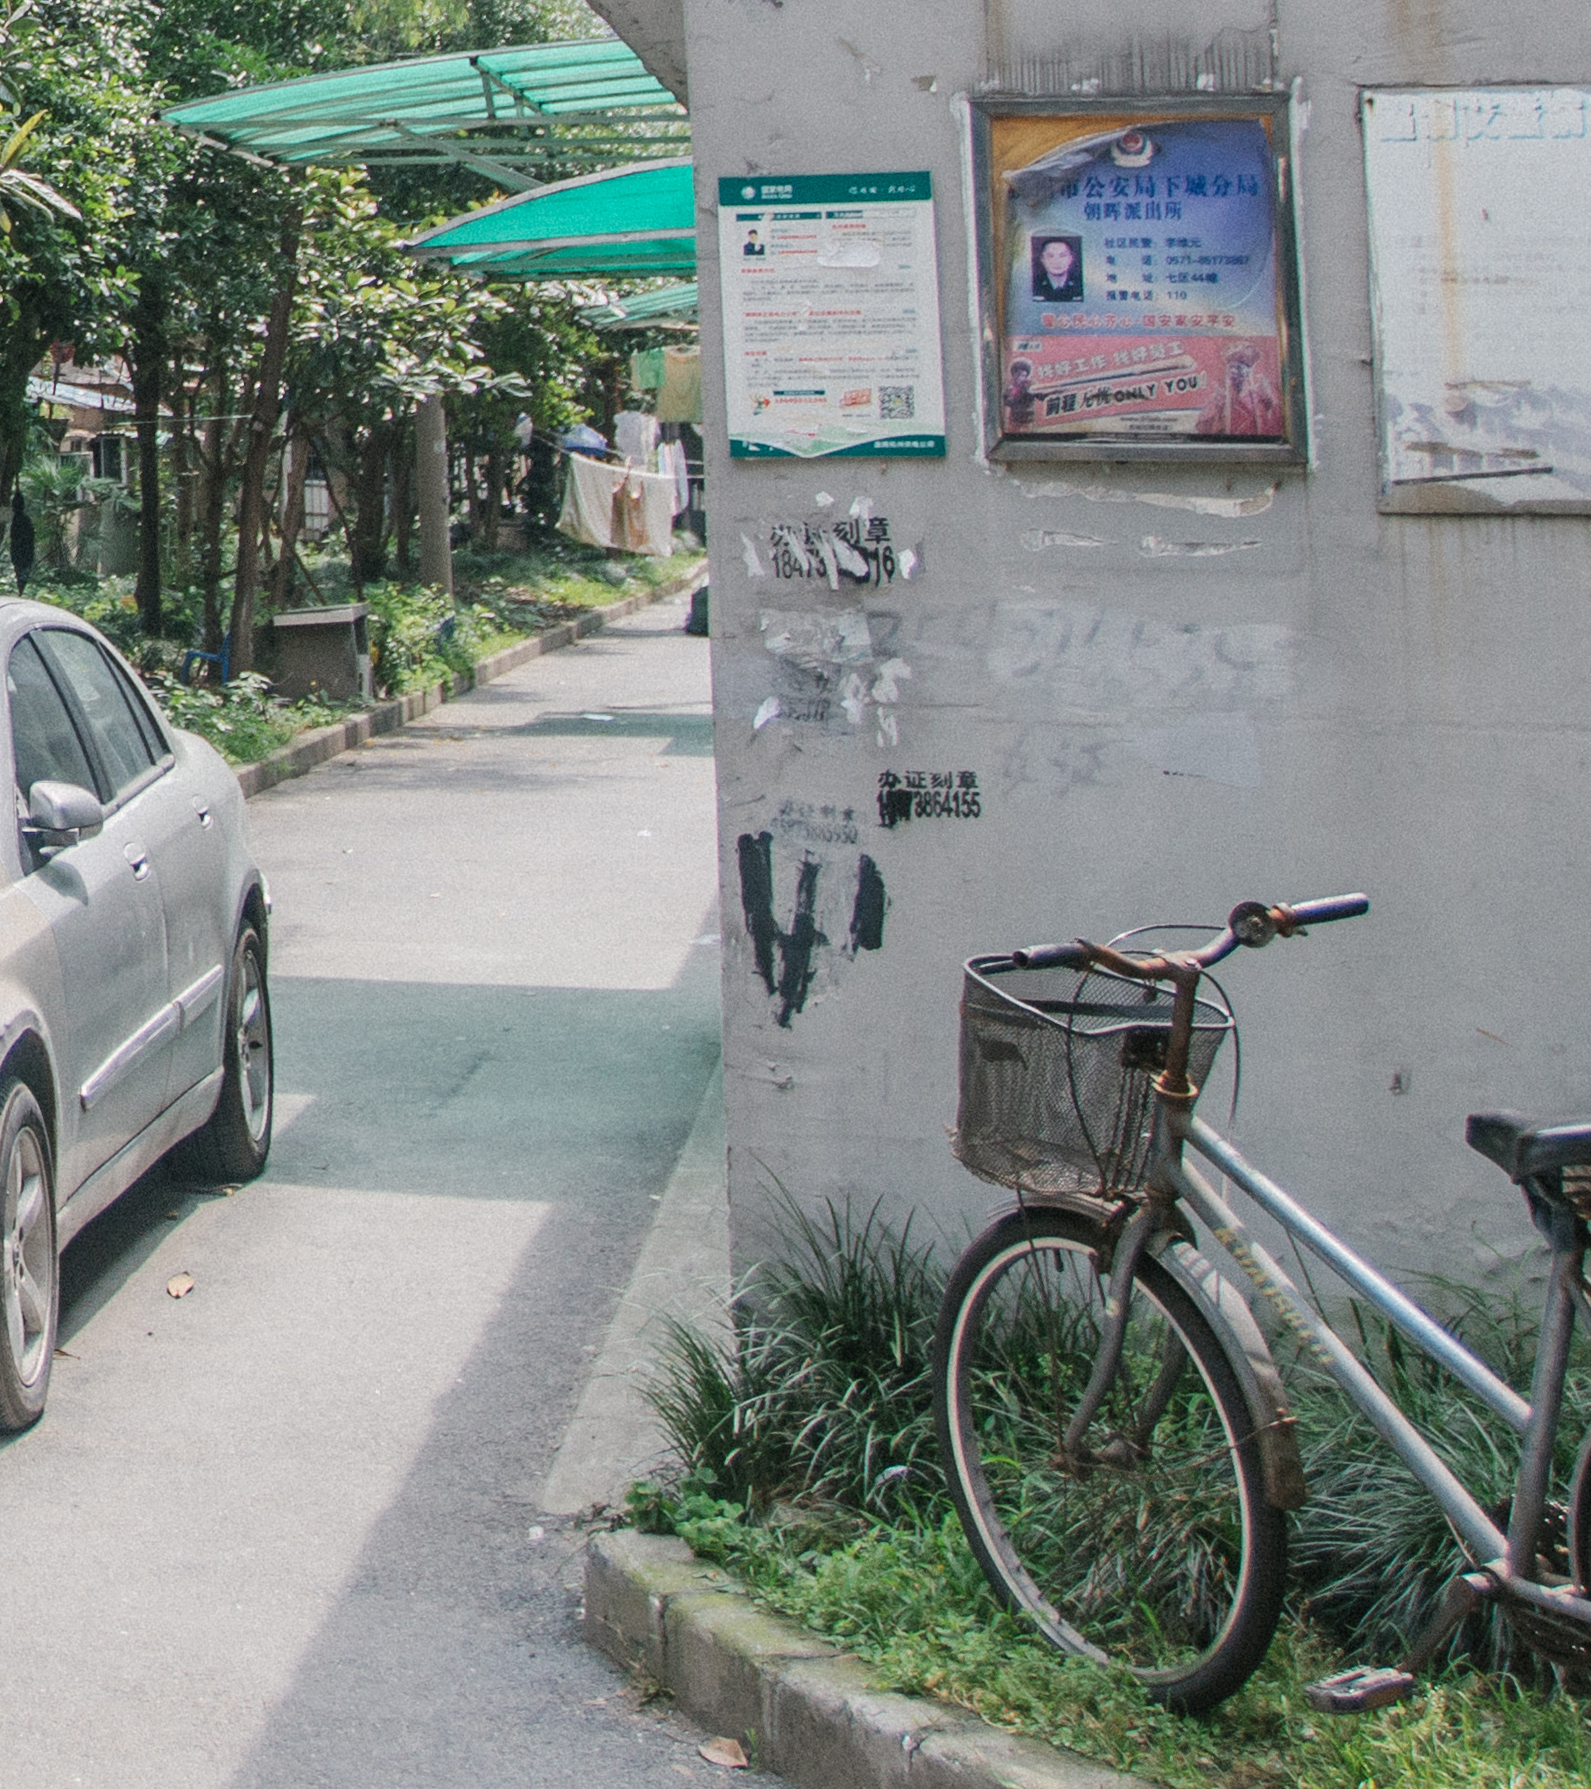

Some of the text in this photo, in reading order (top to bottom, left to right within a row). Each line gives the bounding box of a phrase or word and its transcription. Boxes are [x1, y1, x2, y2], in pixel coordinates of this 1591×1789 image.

[1008, 174, 1260, 200] 市公安局下城分局
[1083, 201, 1183, 221] 朝晖派出所
[1166, 291, 1187, 300] 110
[1114, 383, 1156, 403] ONLY
[877, 769, 979, 789] 办证刻章
